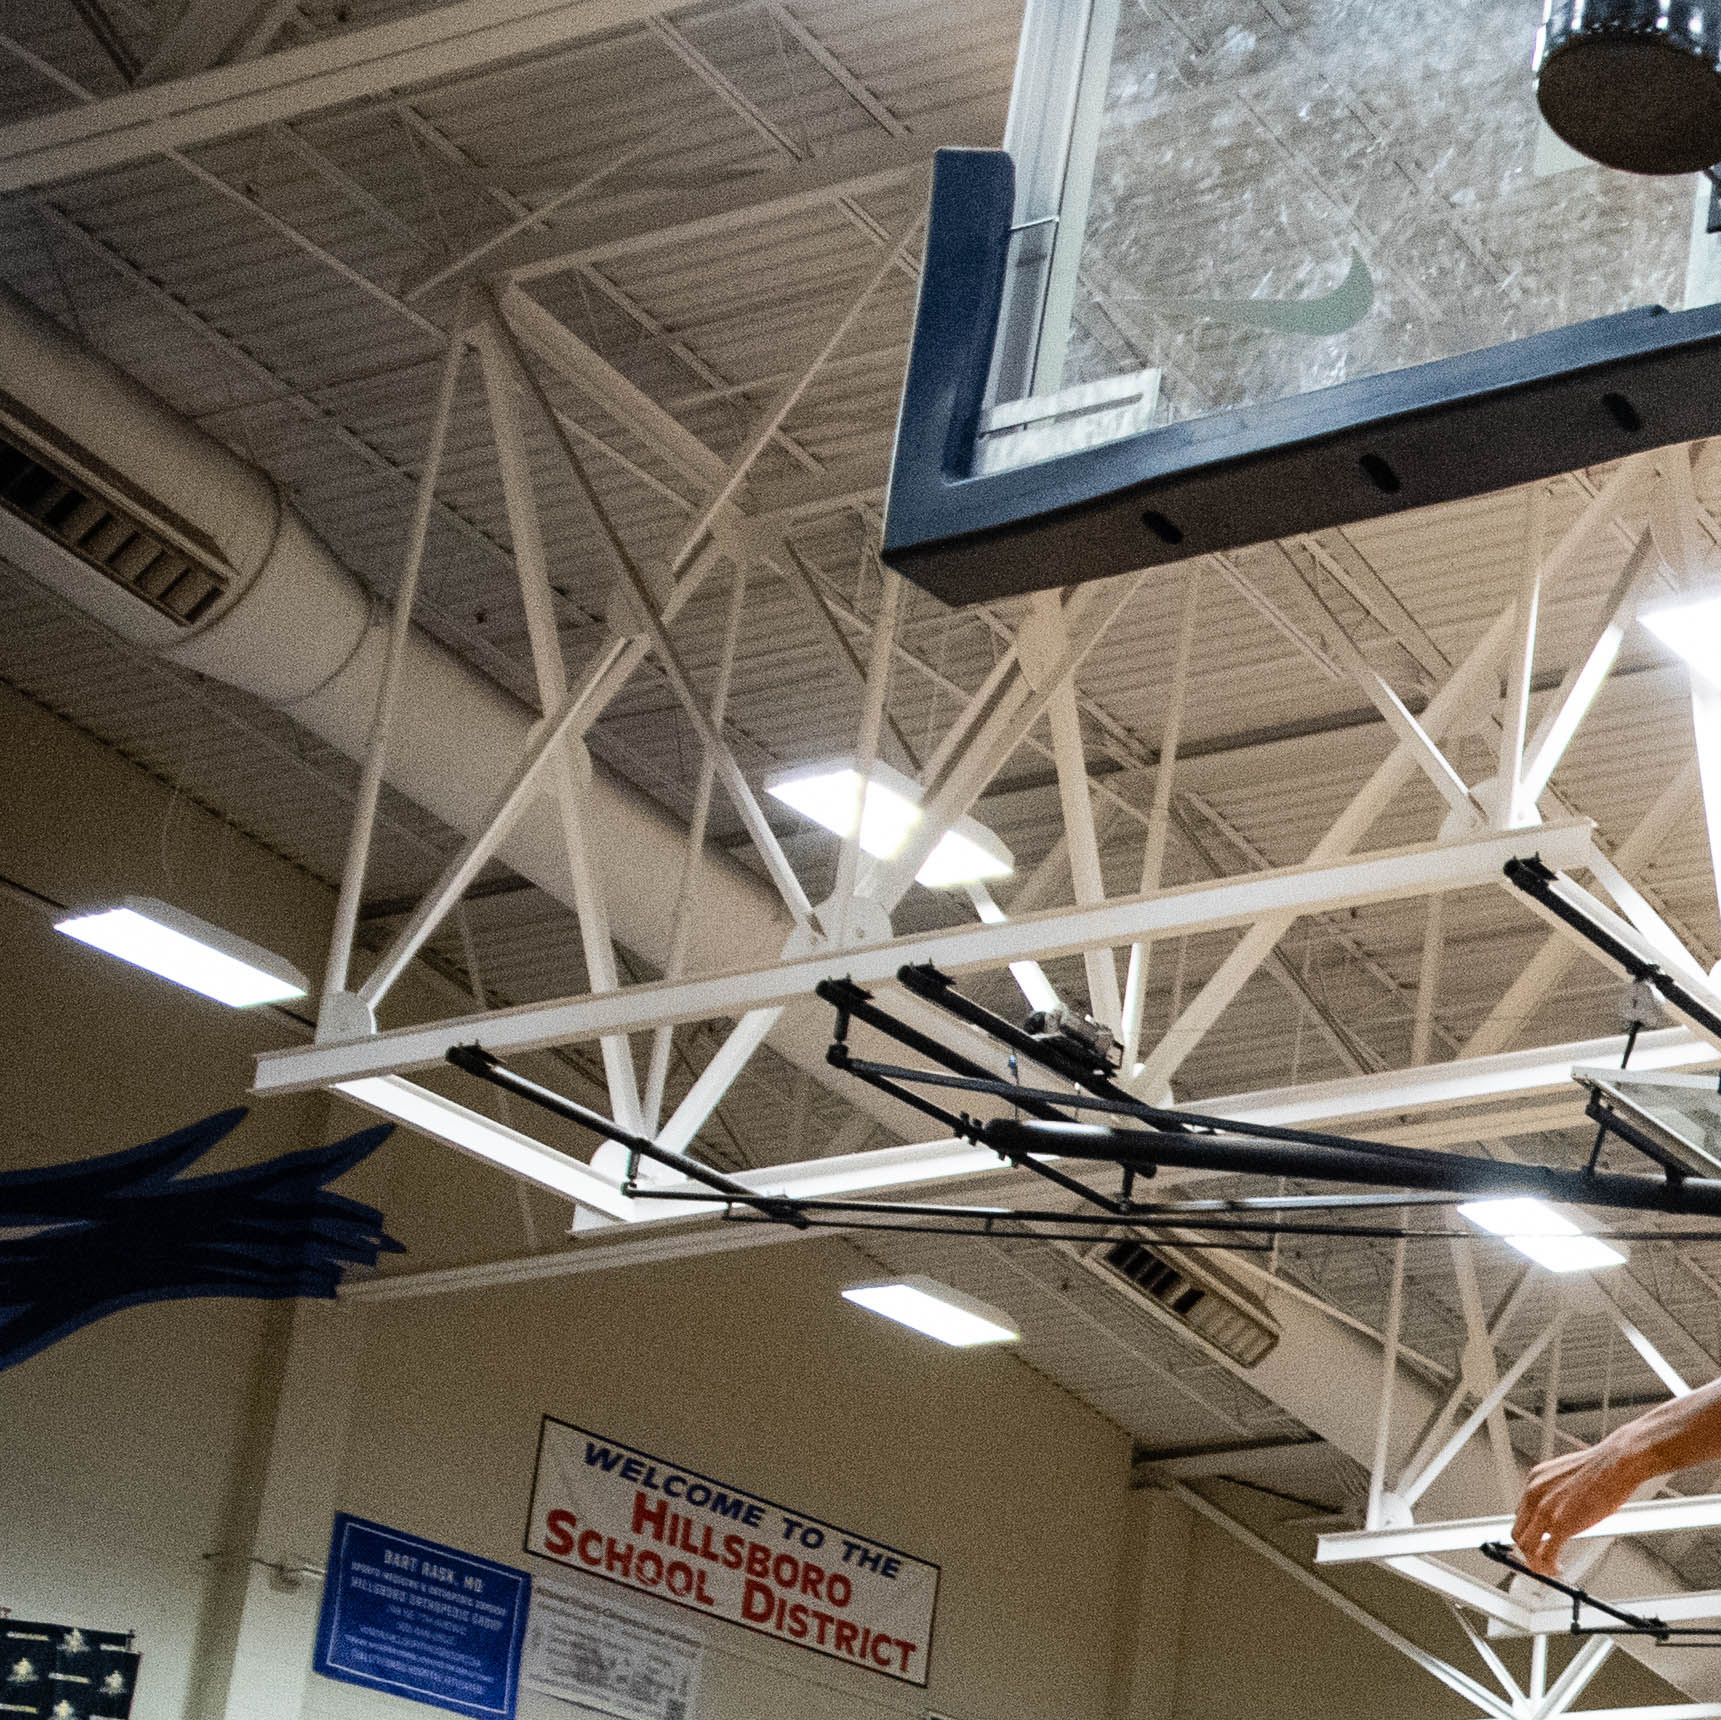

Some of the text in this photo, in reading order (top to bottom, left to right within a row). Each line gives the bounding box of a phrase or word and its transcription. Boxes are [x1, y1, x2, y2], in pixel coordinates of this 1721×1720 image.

[584, 1441, 902, 1579] WELCOME TO THE
[632, 1491, 853, 1608] HILLSBORO
[544, 1508, 715, 1607] SCHOOL
[740, 1579, 917, 1672] DISTRICT
